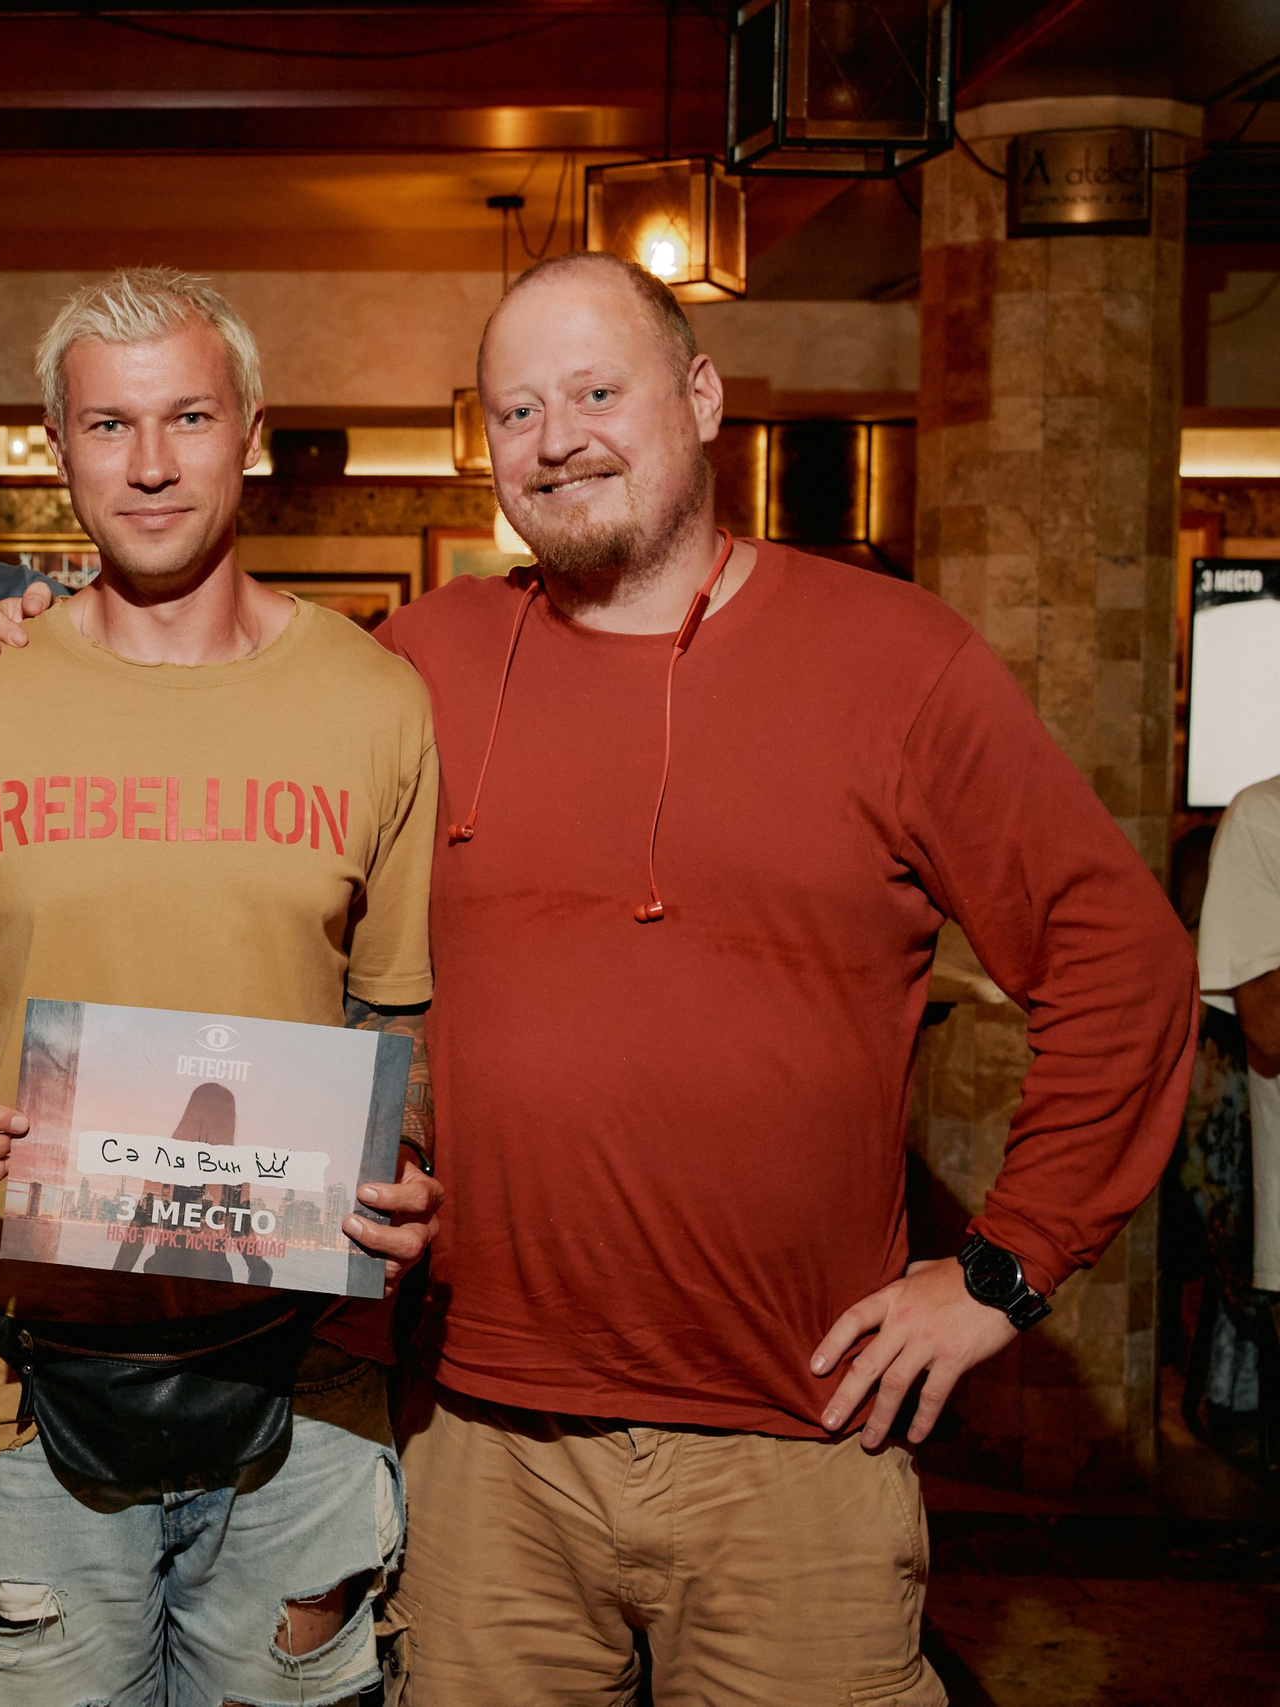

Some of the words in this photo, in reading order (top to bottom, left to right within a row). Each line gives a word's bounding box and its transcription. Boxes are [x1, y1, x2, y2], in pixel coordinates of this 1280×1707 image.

[1214, 569, 1263, 592] МЕСТО
[151, 1200, 276, 1235] МЕСТО
[184, 1234, 287, 1259] ИСЧЕЗНУВШАЯ
